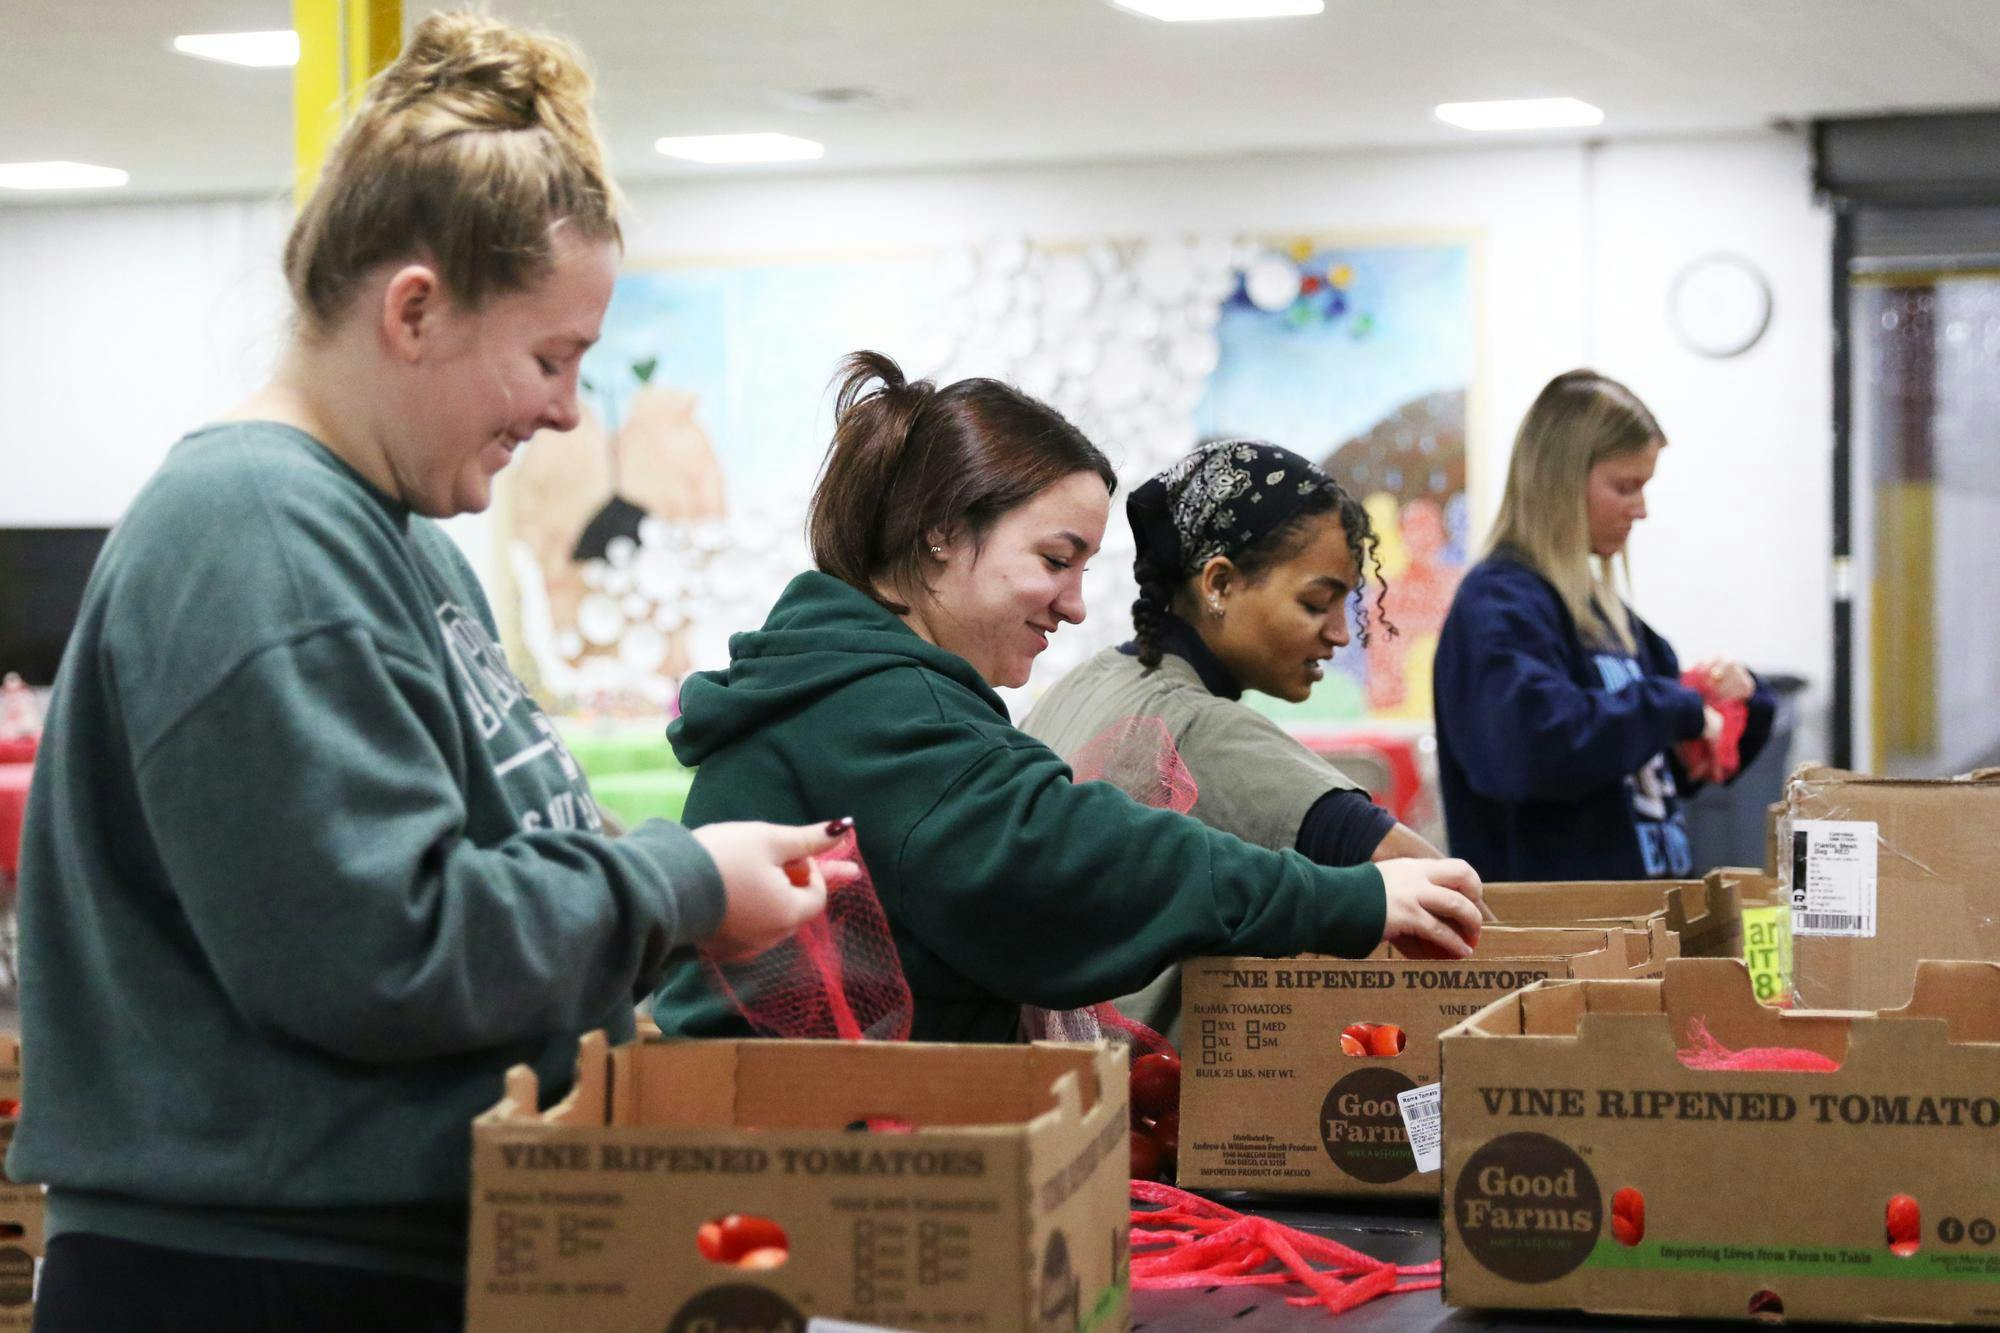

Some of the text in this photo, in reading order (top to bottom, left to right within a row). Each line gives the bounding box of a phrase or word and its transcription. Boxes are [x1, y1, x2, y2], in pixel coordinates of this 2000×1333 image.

[1202, 970, 1268, 989] NE
[1275, 970, 1395, 989] RIPENED
[1194, 1004, 1292, 1015] ROMA TOMATOES
[1439, 1005, 1467, 1015] VINE
[1218, 1022, 1236, 1031] XXL
[1262, 1022, 1286, 1031] MED
[1218, 1037, 1231, 1046] XL
[1262, 1038, 1278, 1047] SM
[1218, 1053, 1232, 1062] LG
[1196, 1068, 1296, 1078] BULK 25 LBS. NET WT.
[1338, 1093, 1403, 1117] Goo
[1478, 1088, 1584, 1117] VINE
[1596, 1089, 1797, 1122] RIPENED
[1327, 1119, 1411, 1143] Farm
[501, 1143, 987, 1177] VINE RIPENED TOMATOES
[1201, 1168, 1236, 1176] IMPORTED
[1238, 1168, 1271, 1176] PRODUCT
[1273, 1168, 1281, 1176] OF
[1478, 1165, 1578, 1198] Good
[1463, 1199, 1594, 1232] Farms
[1660, 1246, 1721, 1262] Improving
[1822, 1250, 1837, 1263] to
